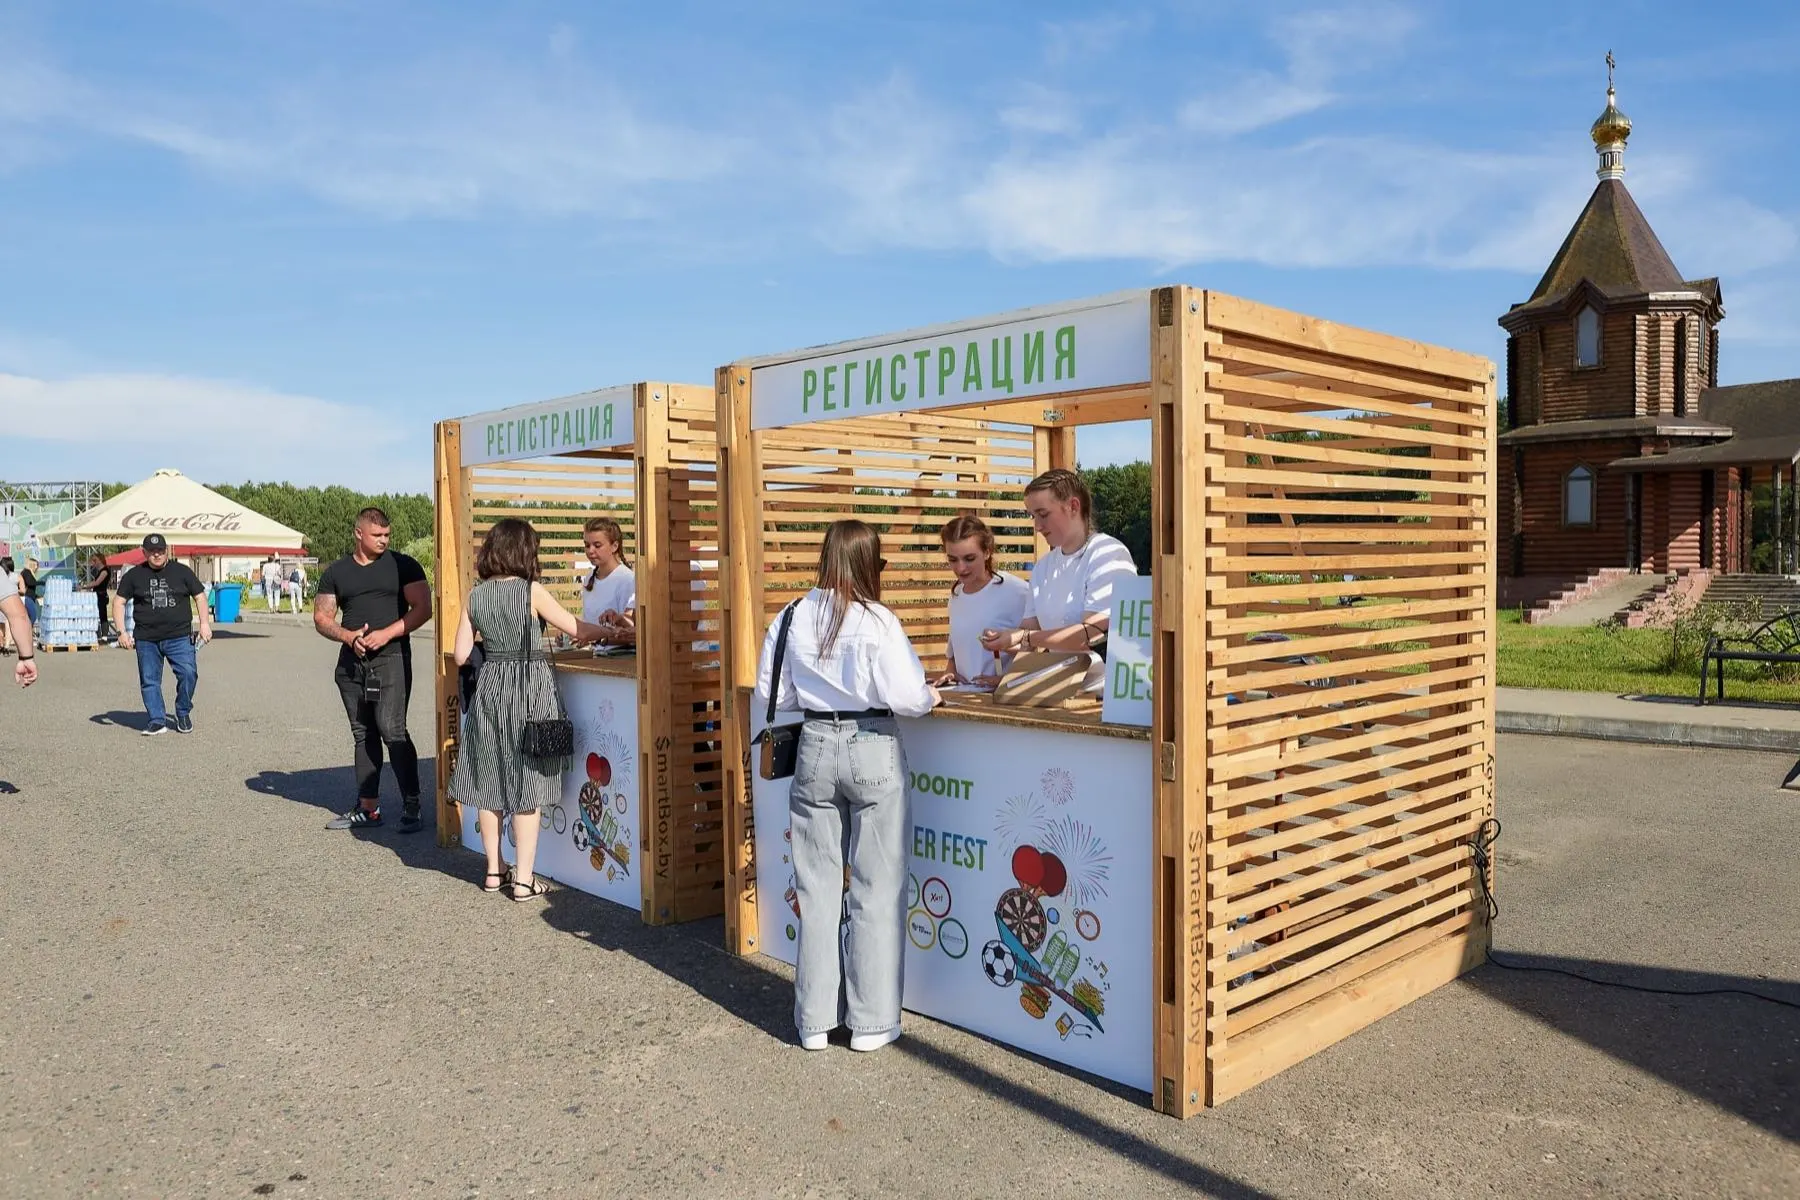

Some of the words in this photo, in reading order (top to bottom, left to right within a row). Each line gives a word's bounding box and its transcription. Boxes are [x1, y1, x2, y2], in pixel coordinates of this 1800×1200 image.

[803, 325, 1076, 413] РЕГИСТРАЦИЯ
[487, 403, 614, 456] РЕГИСТРАЦИЯ
[1118, 600, 1152, 637] HE
[654, 736, 672, 879] SmartBox.by
[911, 825, 936, 861] ER
[941, 831, 988, 871] FEST
[1187, 830, 1204, 1046] SmartBox.by
